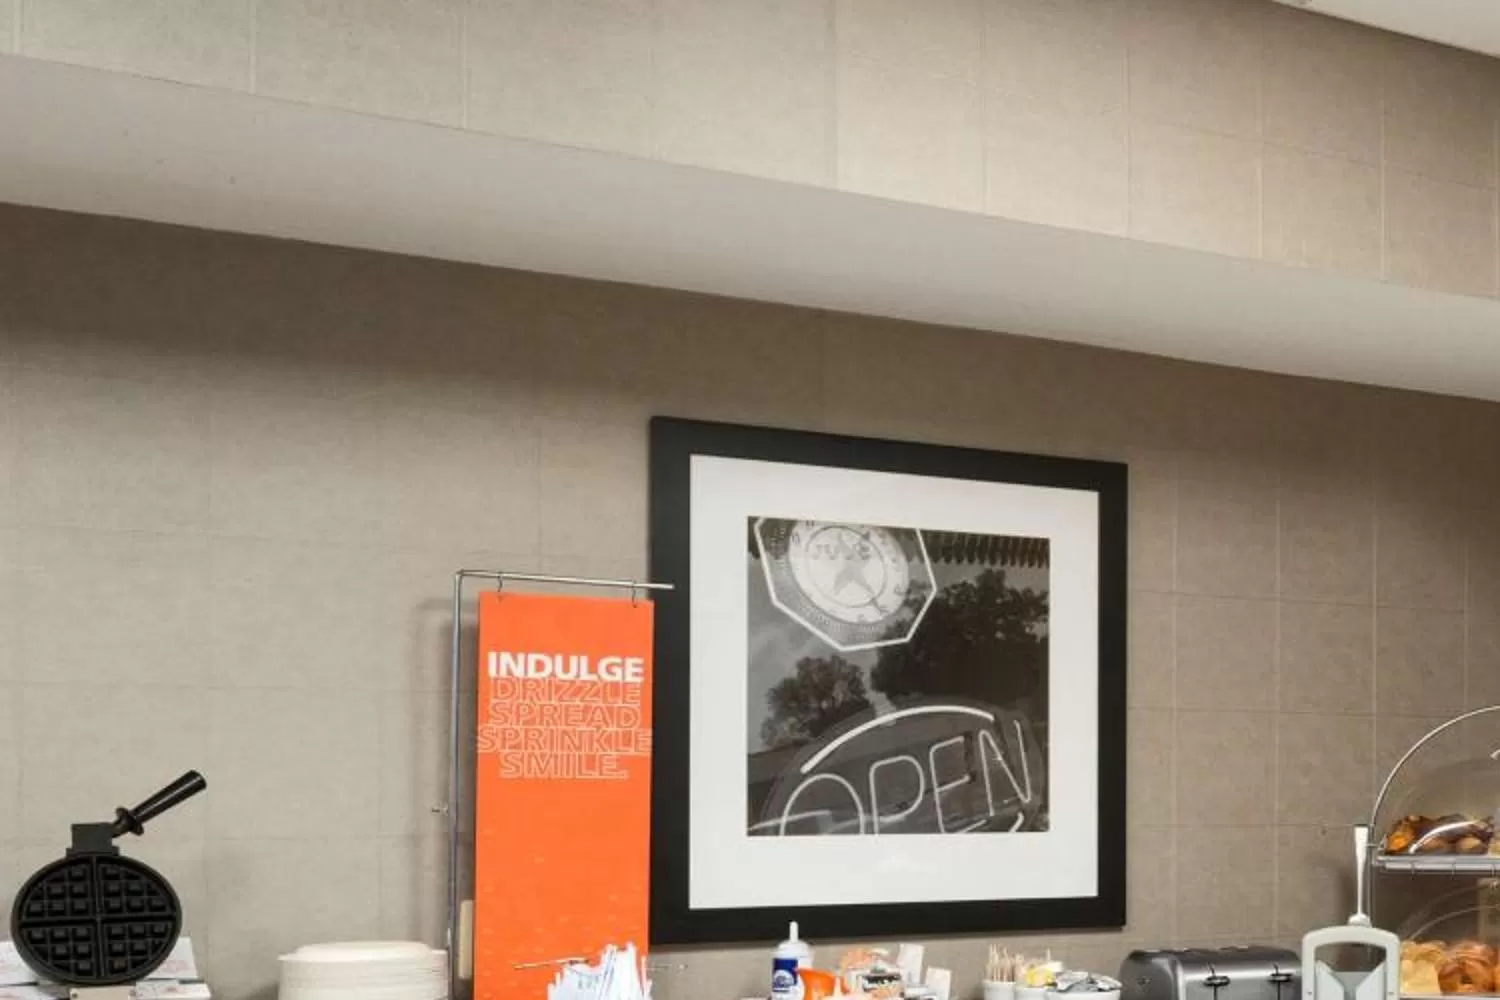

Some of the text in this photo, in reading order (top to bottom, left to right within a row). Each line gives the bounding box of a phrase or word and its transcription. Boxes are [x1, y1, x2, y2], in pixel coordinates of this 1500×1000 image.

[487, 651, 645, 682] INDULGE
[490, 677, 641, 705] DRIZZLE
[489, 700, 641, 730] SPREAD
[476, 724, 654, 757] SPRINKLE
[780, 718, 1032, 836] OPEN
